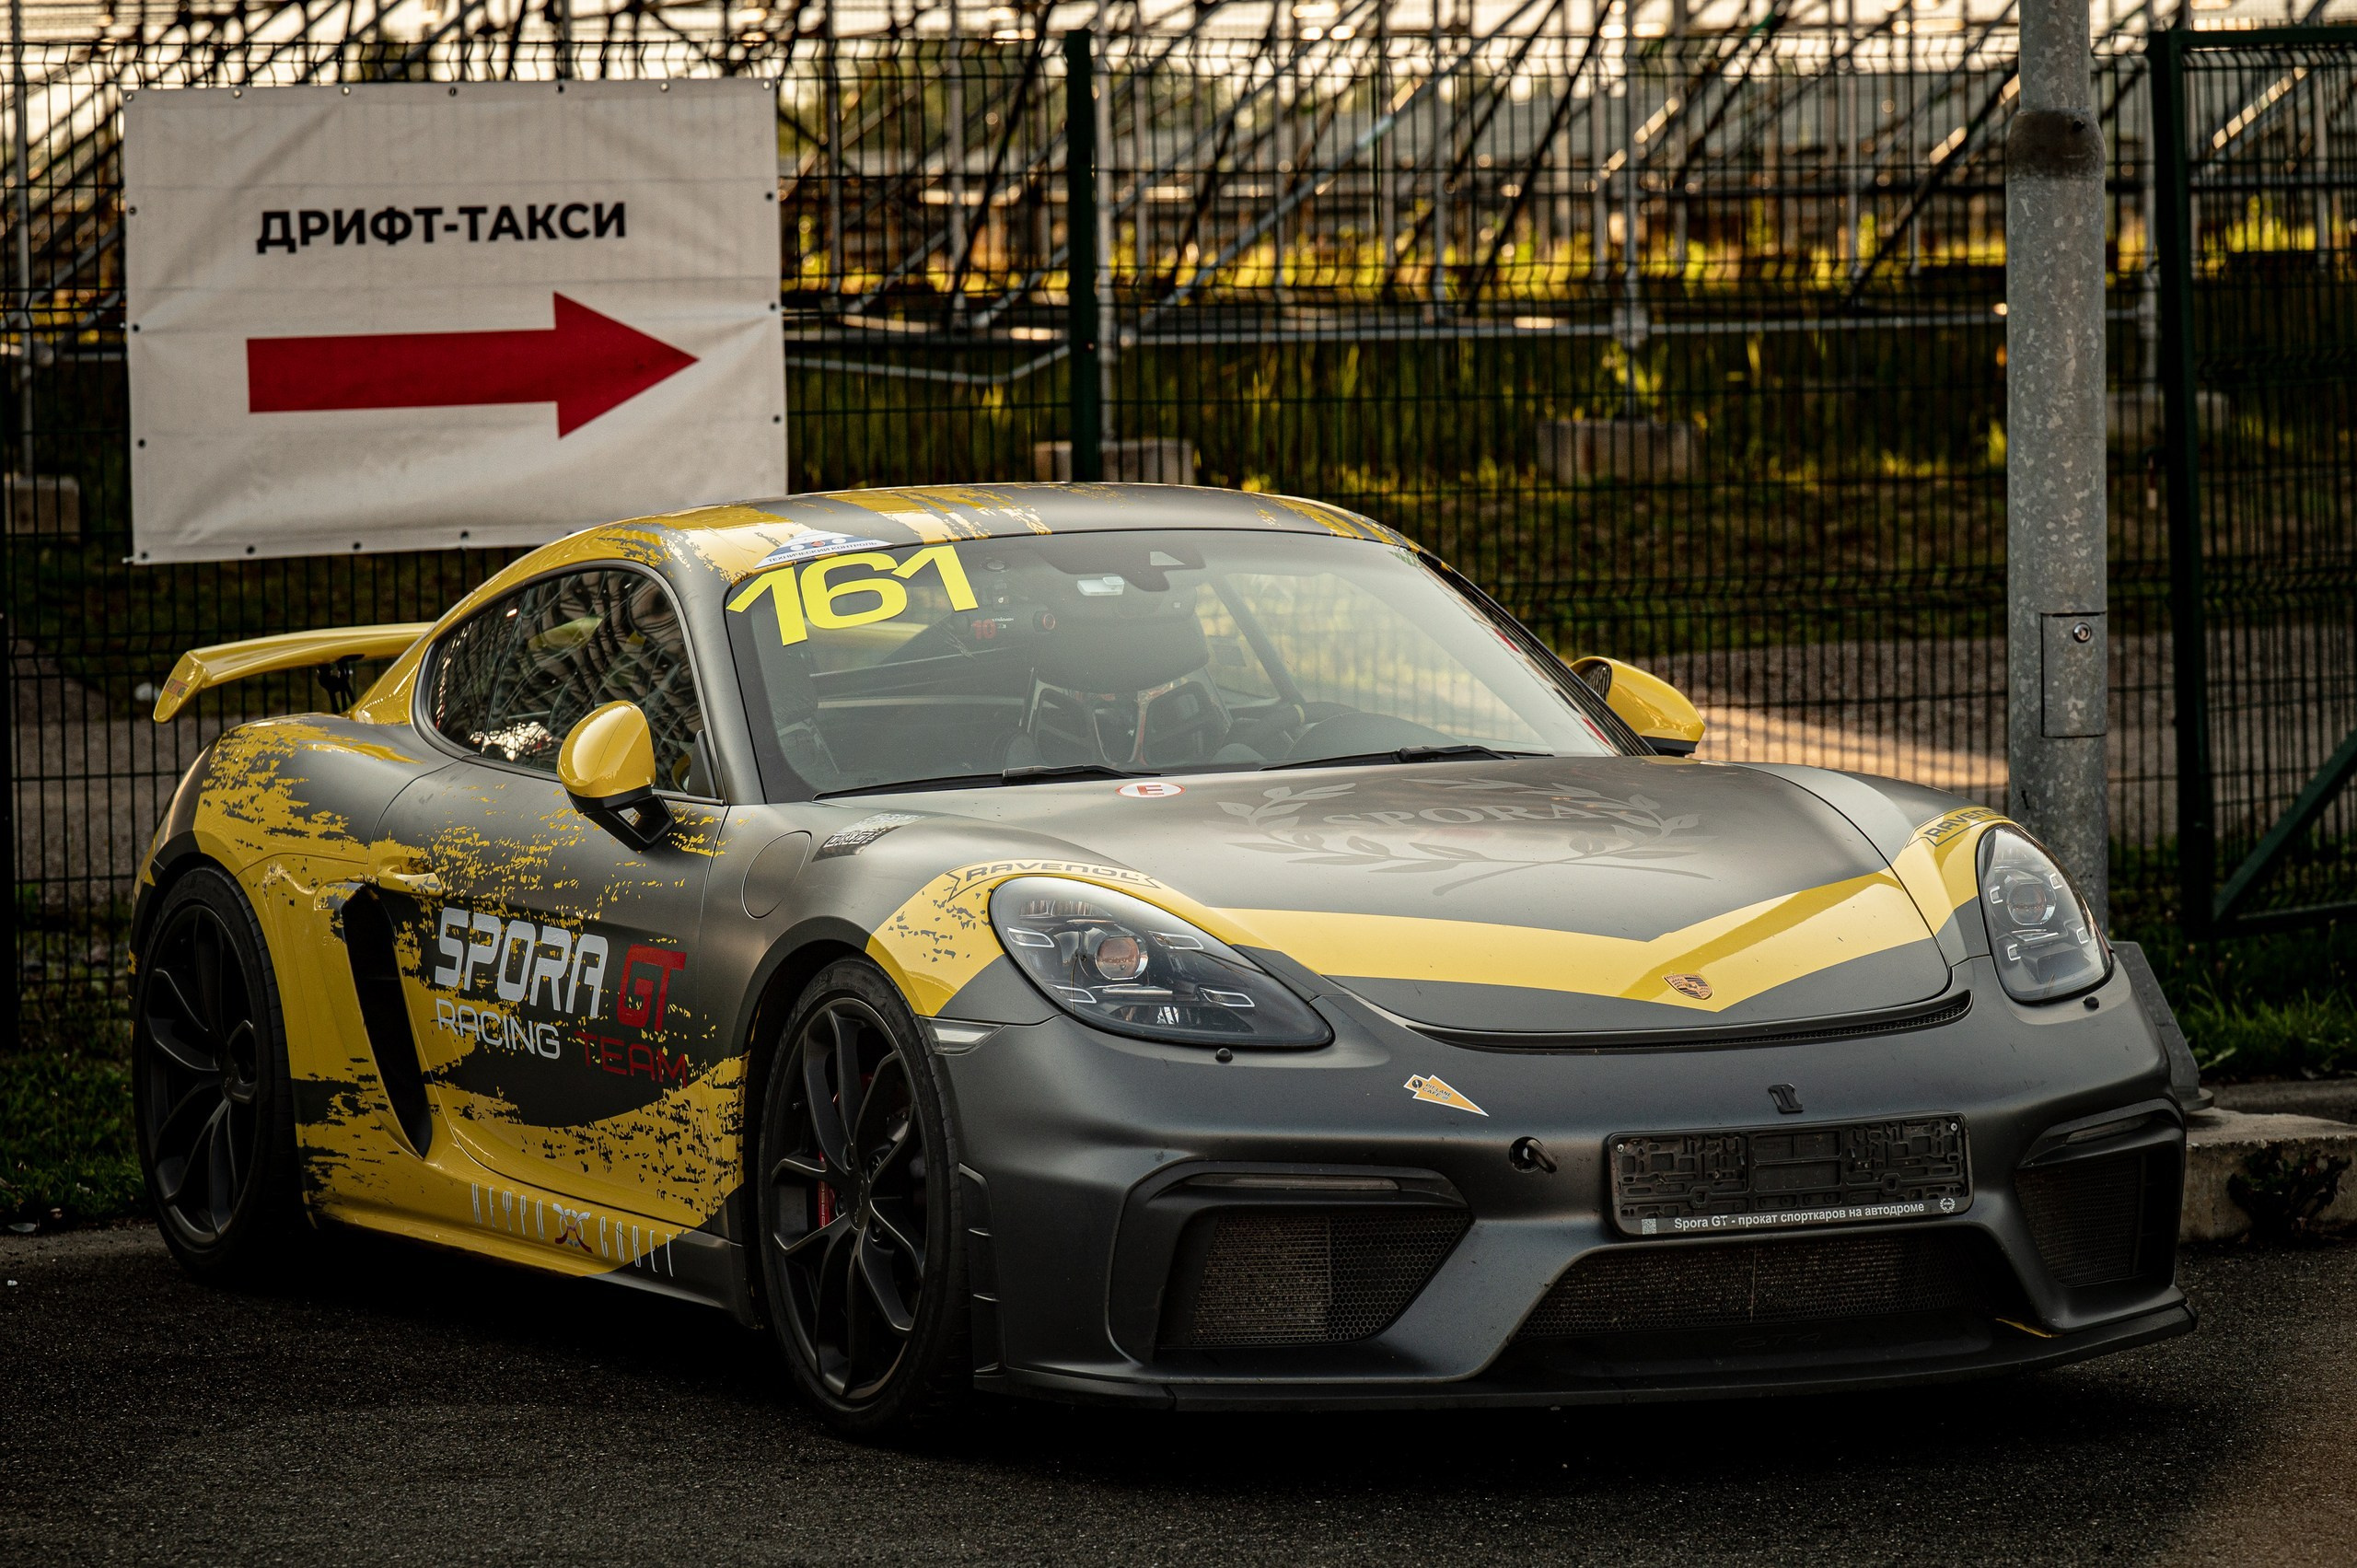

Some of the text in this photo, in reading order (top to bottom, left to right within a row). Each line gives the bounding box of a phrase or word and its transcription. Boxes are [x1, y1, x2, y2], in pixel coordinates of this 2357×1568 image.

[256, 202, 626, 254] ДРИФТ-ТАКСИ
[831, 541, 877, 552] КОНТРОЛЬ
[726, 545, 979, 646] 161
[1136, 785, 1165, 796] E
[1323, 804, 1608, 830] SPORA
[1924, 808, 2001, 838] RAVEN
[966, 862, 1142, 882] RAVENOL
[435, 907, 687, 1032] SPORA GT
[435, 998, 688, 1088] RACING TEAM
[1674, 1216, 1709, 1231] Spora
[1711, 1214, 1728, 1227] GT
[1738, 1214, 1777, 1227] прокат
[1781, 1210, 1846, 1225] спорткаров
[1849, 1207, 1863, 1217] на
[1864, 1202, 1924, 1217] автодроме
